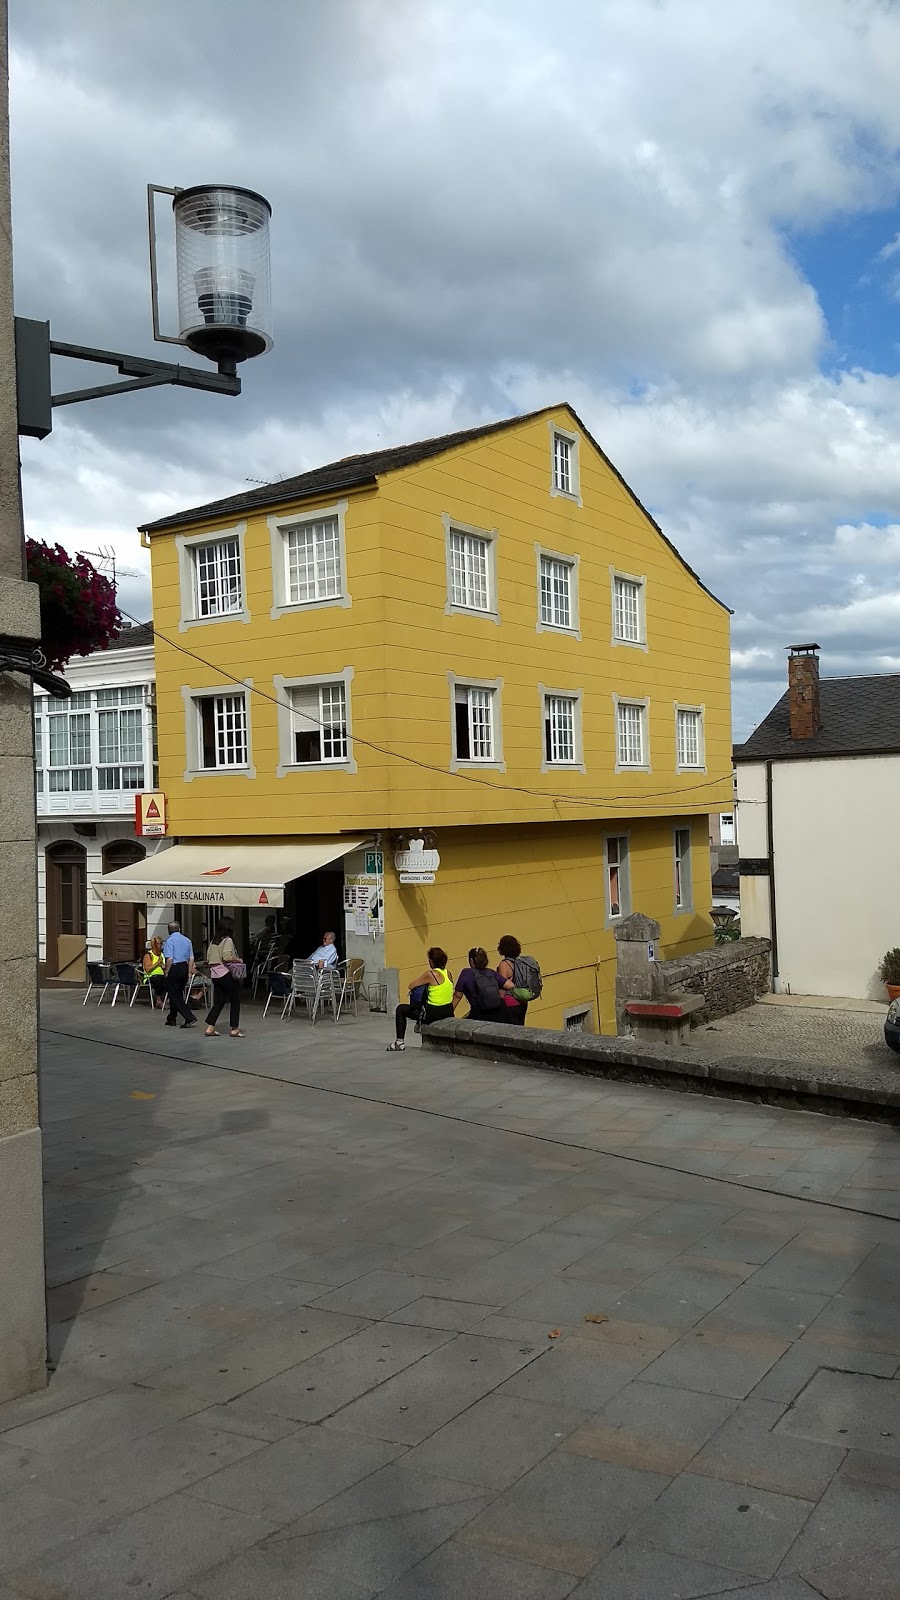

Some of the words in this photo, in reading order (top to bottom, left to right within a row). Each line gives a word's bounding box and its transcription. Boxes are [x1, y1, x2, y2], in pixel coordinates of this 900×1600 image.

[367, 854, 382, 867] PR
[146, 889, 177, 900] PENSIÓN
[180, 890, 225, 902] ESCALINATA
